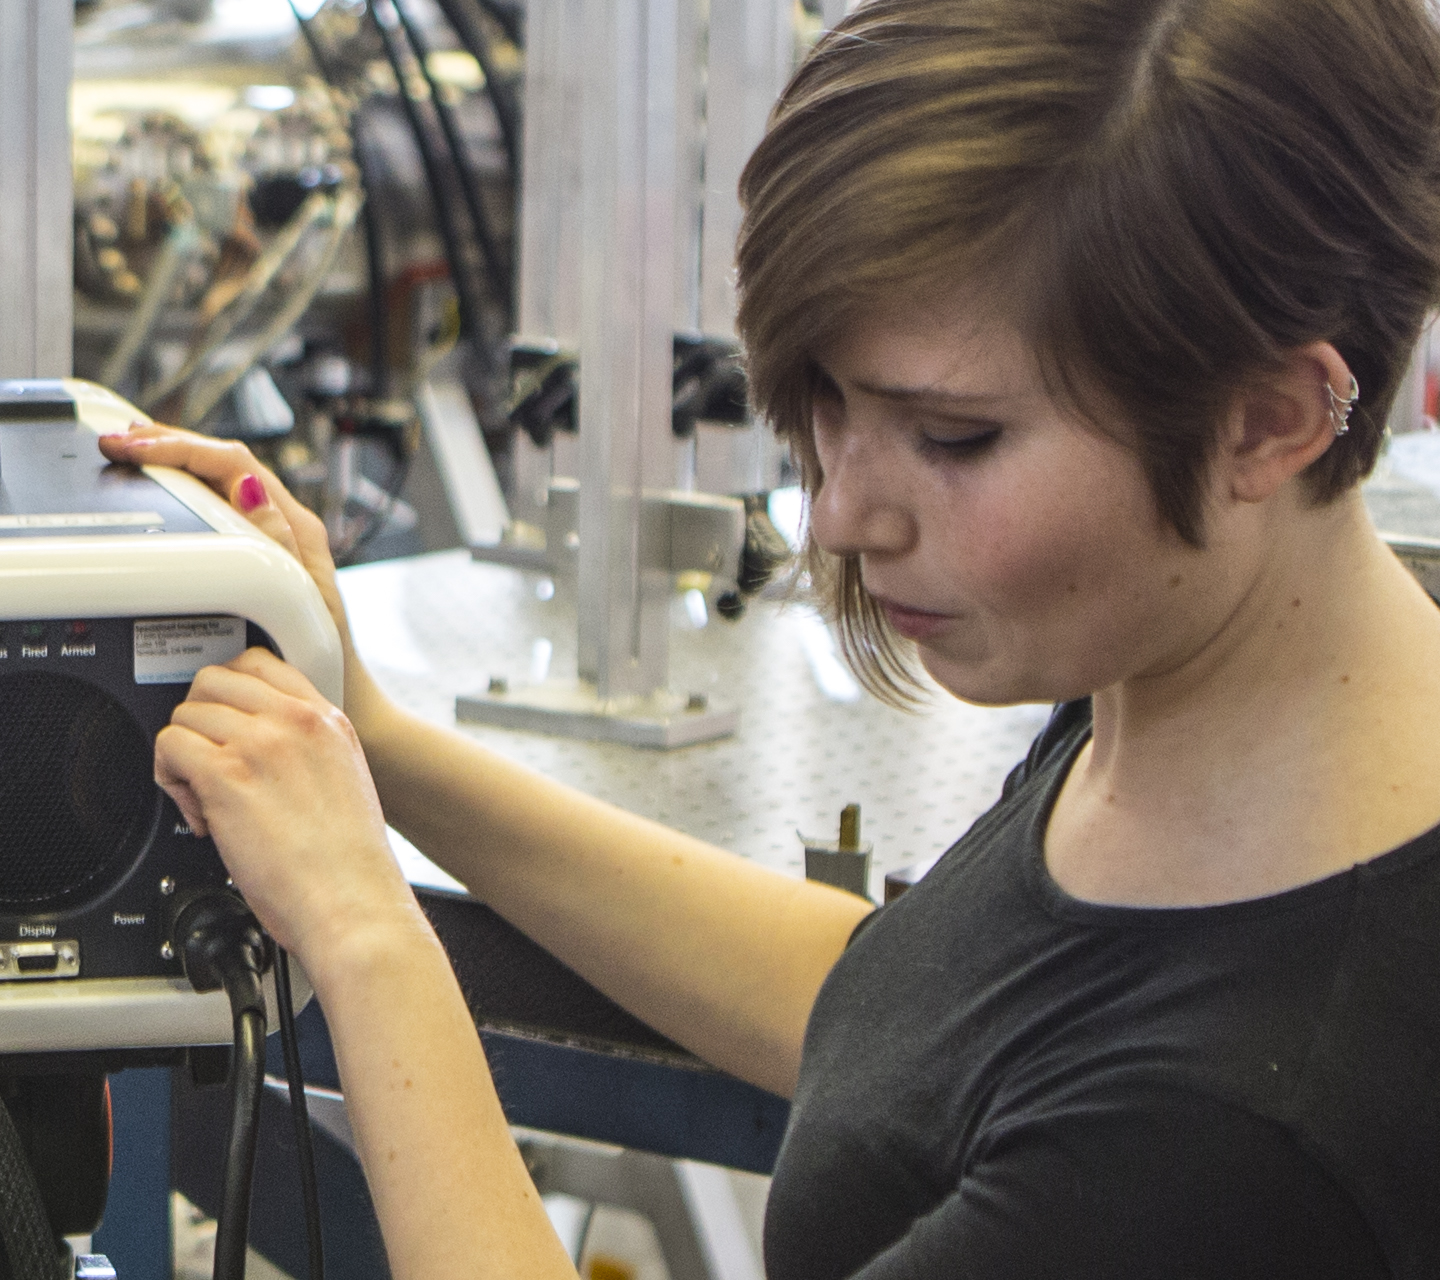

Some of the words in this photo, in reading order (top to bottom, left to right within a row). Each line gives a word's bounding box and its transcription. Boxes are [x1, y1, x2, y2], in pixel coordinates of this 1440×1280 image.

[22, 644, 48, 658] Fired
[61, 643, 96, 657] Armed
[113, 912, 145, 925] Power
[20, 923, 57, 938] Display
